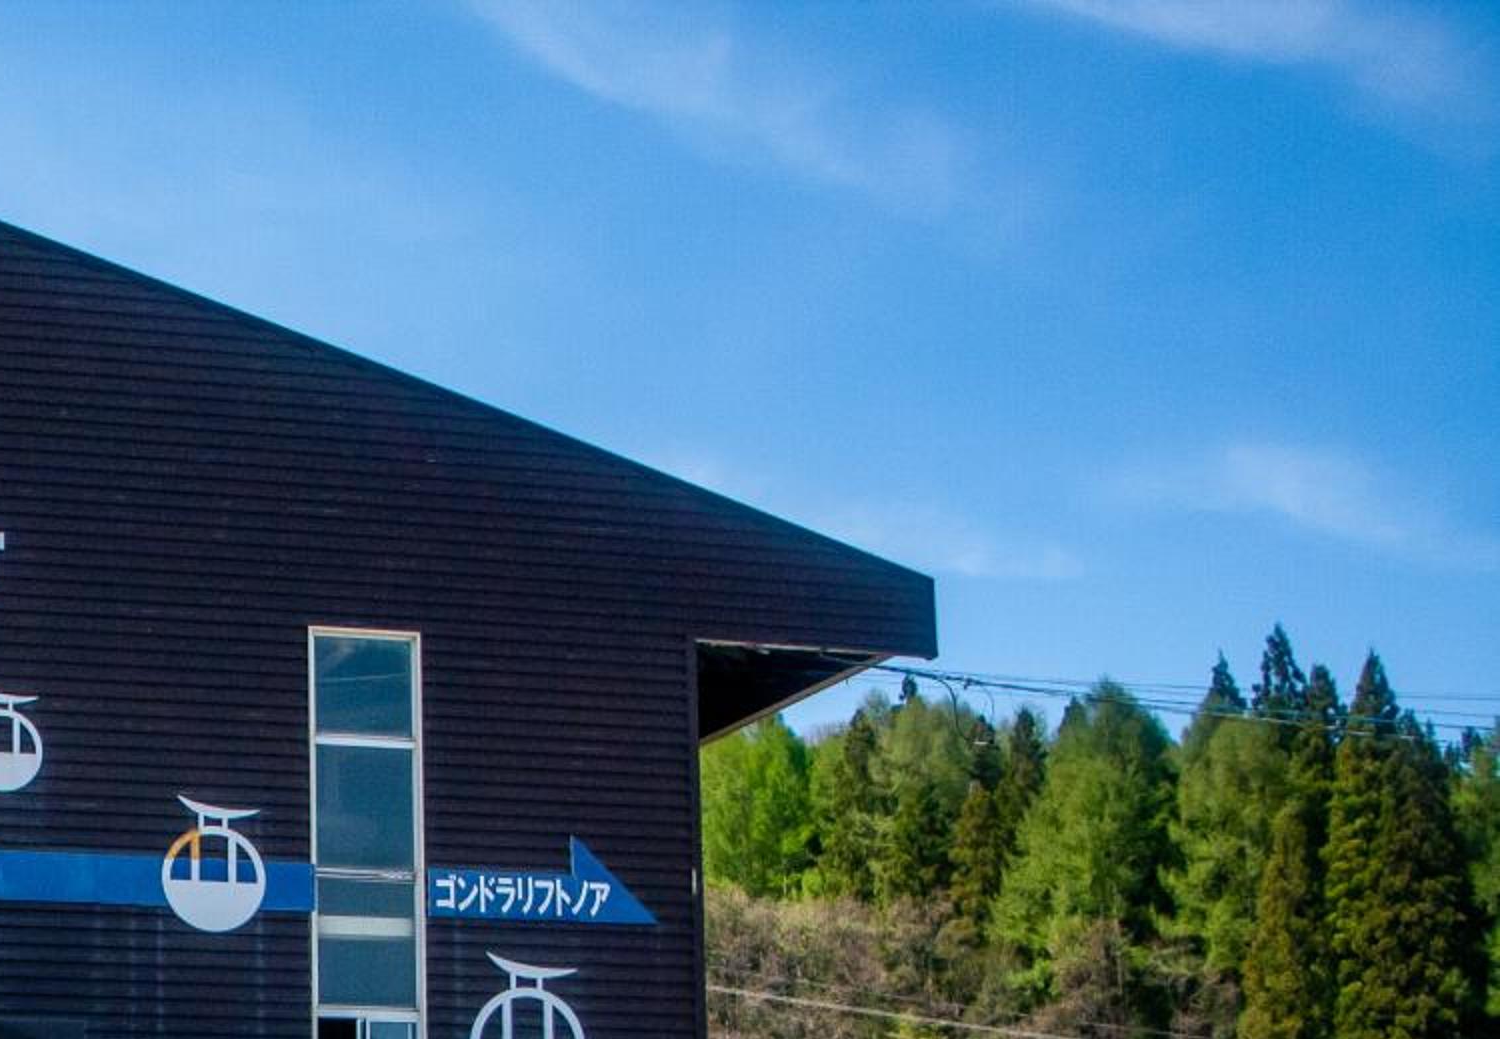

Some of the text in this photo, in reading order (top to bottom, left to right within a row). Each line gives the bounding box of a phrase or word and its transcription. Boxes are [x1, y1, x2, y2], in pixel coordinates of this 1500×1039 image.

[435, 874, 611, 917] ゴンドラリフトノア
